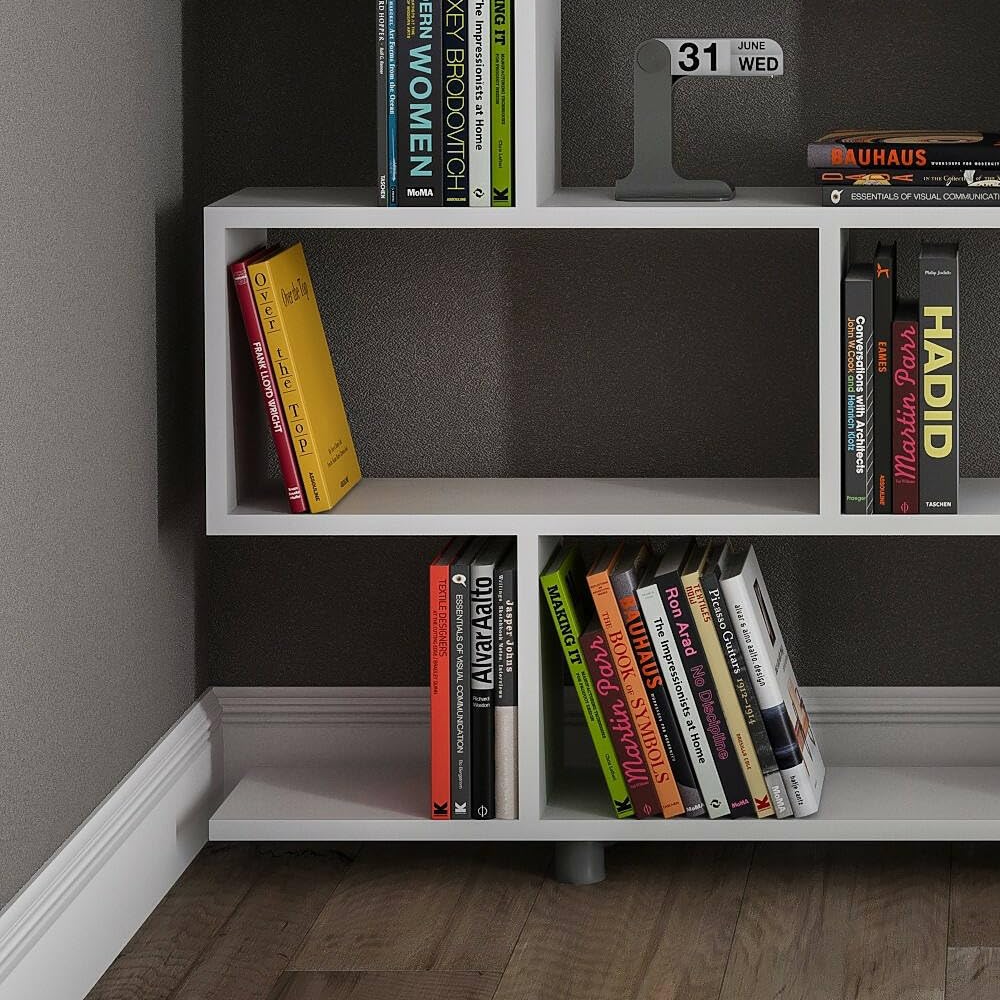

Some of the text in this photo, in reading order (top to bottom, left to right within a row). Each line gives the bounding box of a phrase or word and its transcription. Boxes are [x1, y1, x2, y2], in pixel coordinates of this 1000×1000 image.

[474, 20, 484, 100] Impressionists
[494, 30, 506, 46] IT
[678, 42, 718, 72] 31
[738, 42, 766, 50] JUNE
[738, 56, 779, 72] WED
[410, 44, 432, 176] WOMEN
[446, 48, 466, 190] BRODOVITCH
[476, 104, 484, 116] at
[476, 120, 484, 150] Home
[831, 148, 927, 166] BAUHAUS
[407, 188, 434, 196] MoMA
[851, 192, 899, 200] ESSENTIALS
[900, 192, 912, 200] OF
[914, 192, 941, 200] VISUAL
[254, 272, 276, 330] Over
[276, 348, 292, 389] the
[878, 342, 888, 372] EAMES
[894, 326, 916, 386] Parr
[252, 342, 282, 433] FRANK LLOYD WRIGHT
[848, 316, 856, 451] John and Heinrich Klotz
[856, 316, 866, 474] Conversations with Architects
[924, 306, 952, 458] HADID
[894, 393, 916, 480] Martin
[308, 472, 320, 502] ASSOULINE
[438, 580, 448, 657] TEXTILE DESIGNERS
[456, 594, 464, 641] ESSENTIALS
[548, 584, 582, 665] MAKING IT
[694, 584, 711, 622] TEXTILES
[708, 588, 727, 630] Picasso
[722, 630, 740, 674] Guitars
[456, 644, 464, 654] OF
[504, 600, 514, 673] Jasper Johns
[590, 636, 620, 696] Parr
[620, 595, 662, 689] BAUHAUS
[602, 612, 670, 784] THE BOOK OF SYMBOLS
[654, 616, 706, 764] The Impressionists at Home
[666, 586, 728, 760] Ron Arad No Discipline
[610, 698, 649, 785] Martin
[731, 798, 750, 808] MoMA
[771, 784, 786, 812] MoMA
